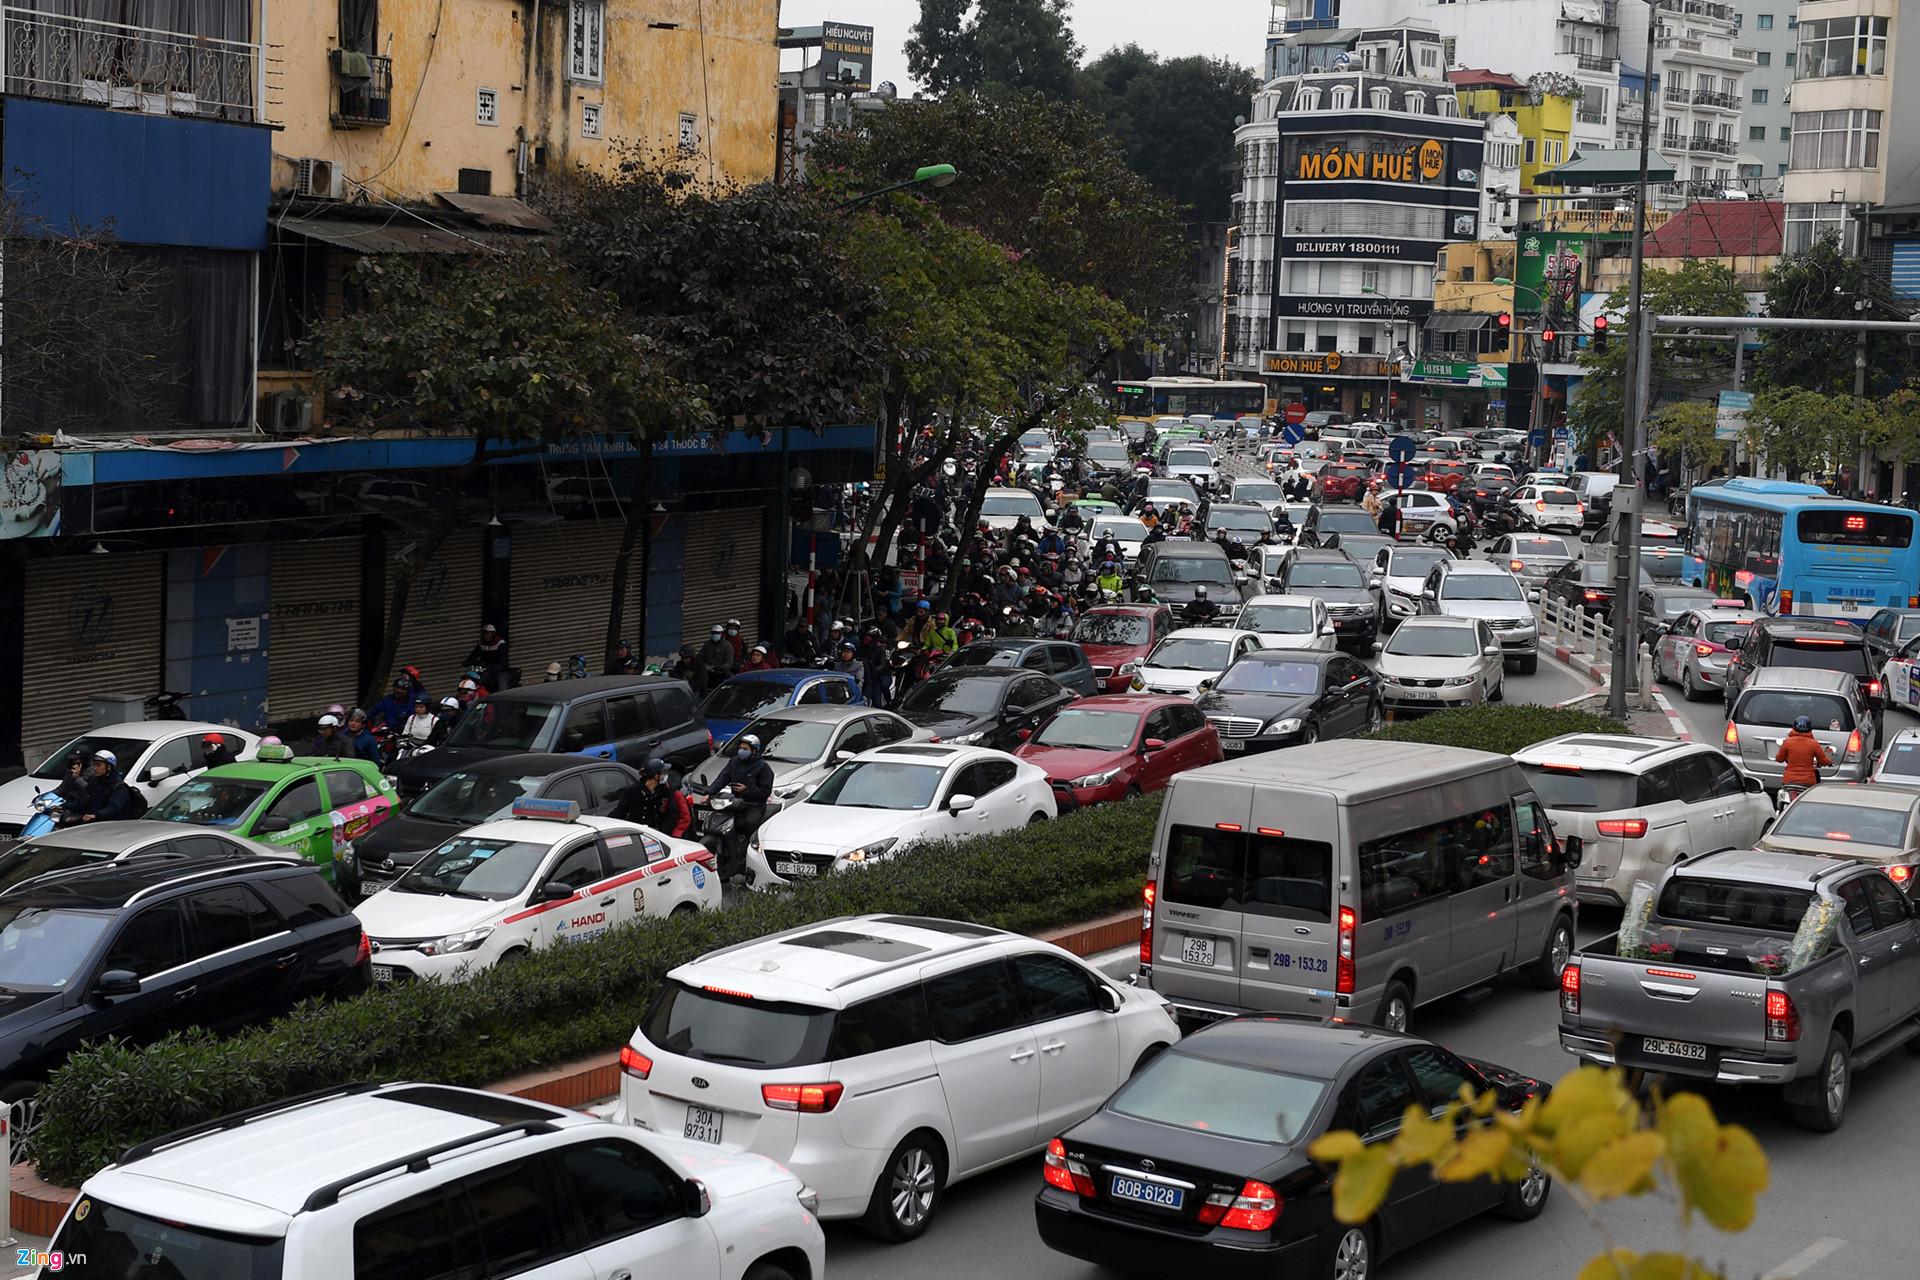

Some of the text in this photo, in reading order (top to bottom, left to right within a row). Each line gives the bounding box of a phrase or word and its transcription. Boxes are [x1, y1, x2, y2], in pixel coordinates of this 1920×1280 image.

[843, 28, 873, 43] NGUYỆT
[1299, 146, 1417, 181] MÓN HUẾ
[1296, 242, 1400, 254] DELIVERY 18001111
[1298, 302, 1333, 314] HƯƠNG
[1334, 304, 1345, 317] VỊ
[571, 911, 606, 929] HANOI
[1190, 939, 1208, 951] 29B
[1273, 952, 1329, 973] 29B 153.28
[695, 1109, 713, 1127] 30A
[686, 1123, 719, 1143] 973.11
